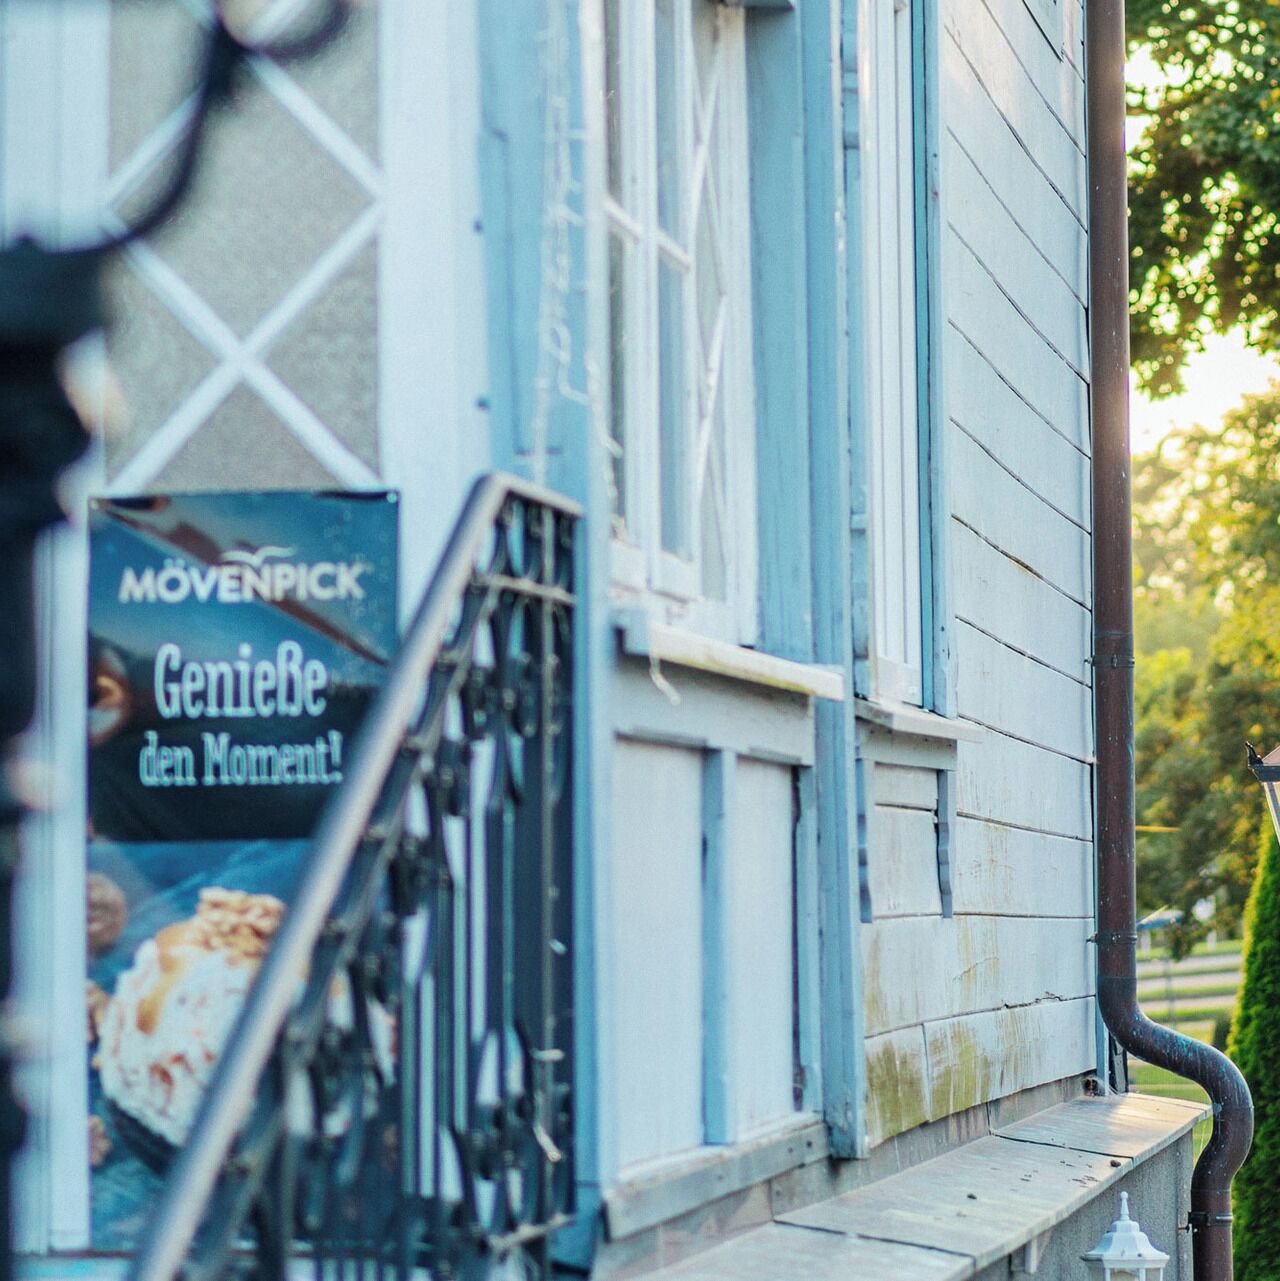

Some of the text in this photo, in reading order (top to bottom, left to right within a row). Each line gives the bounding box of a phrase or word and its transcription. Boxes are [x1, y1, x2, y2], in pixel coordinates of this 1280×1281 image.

[118, 559, 366, 604] MÖVENPICK
[154, 641, 327, 719] Genieße
[139, 730, 344, 787] den Moment!
